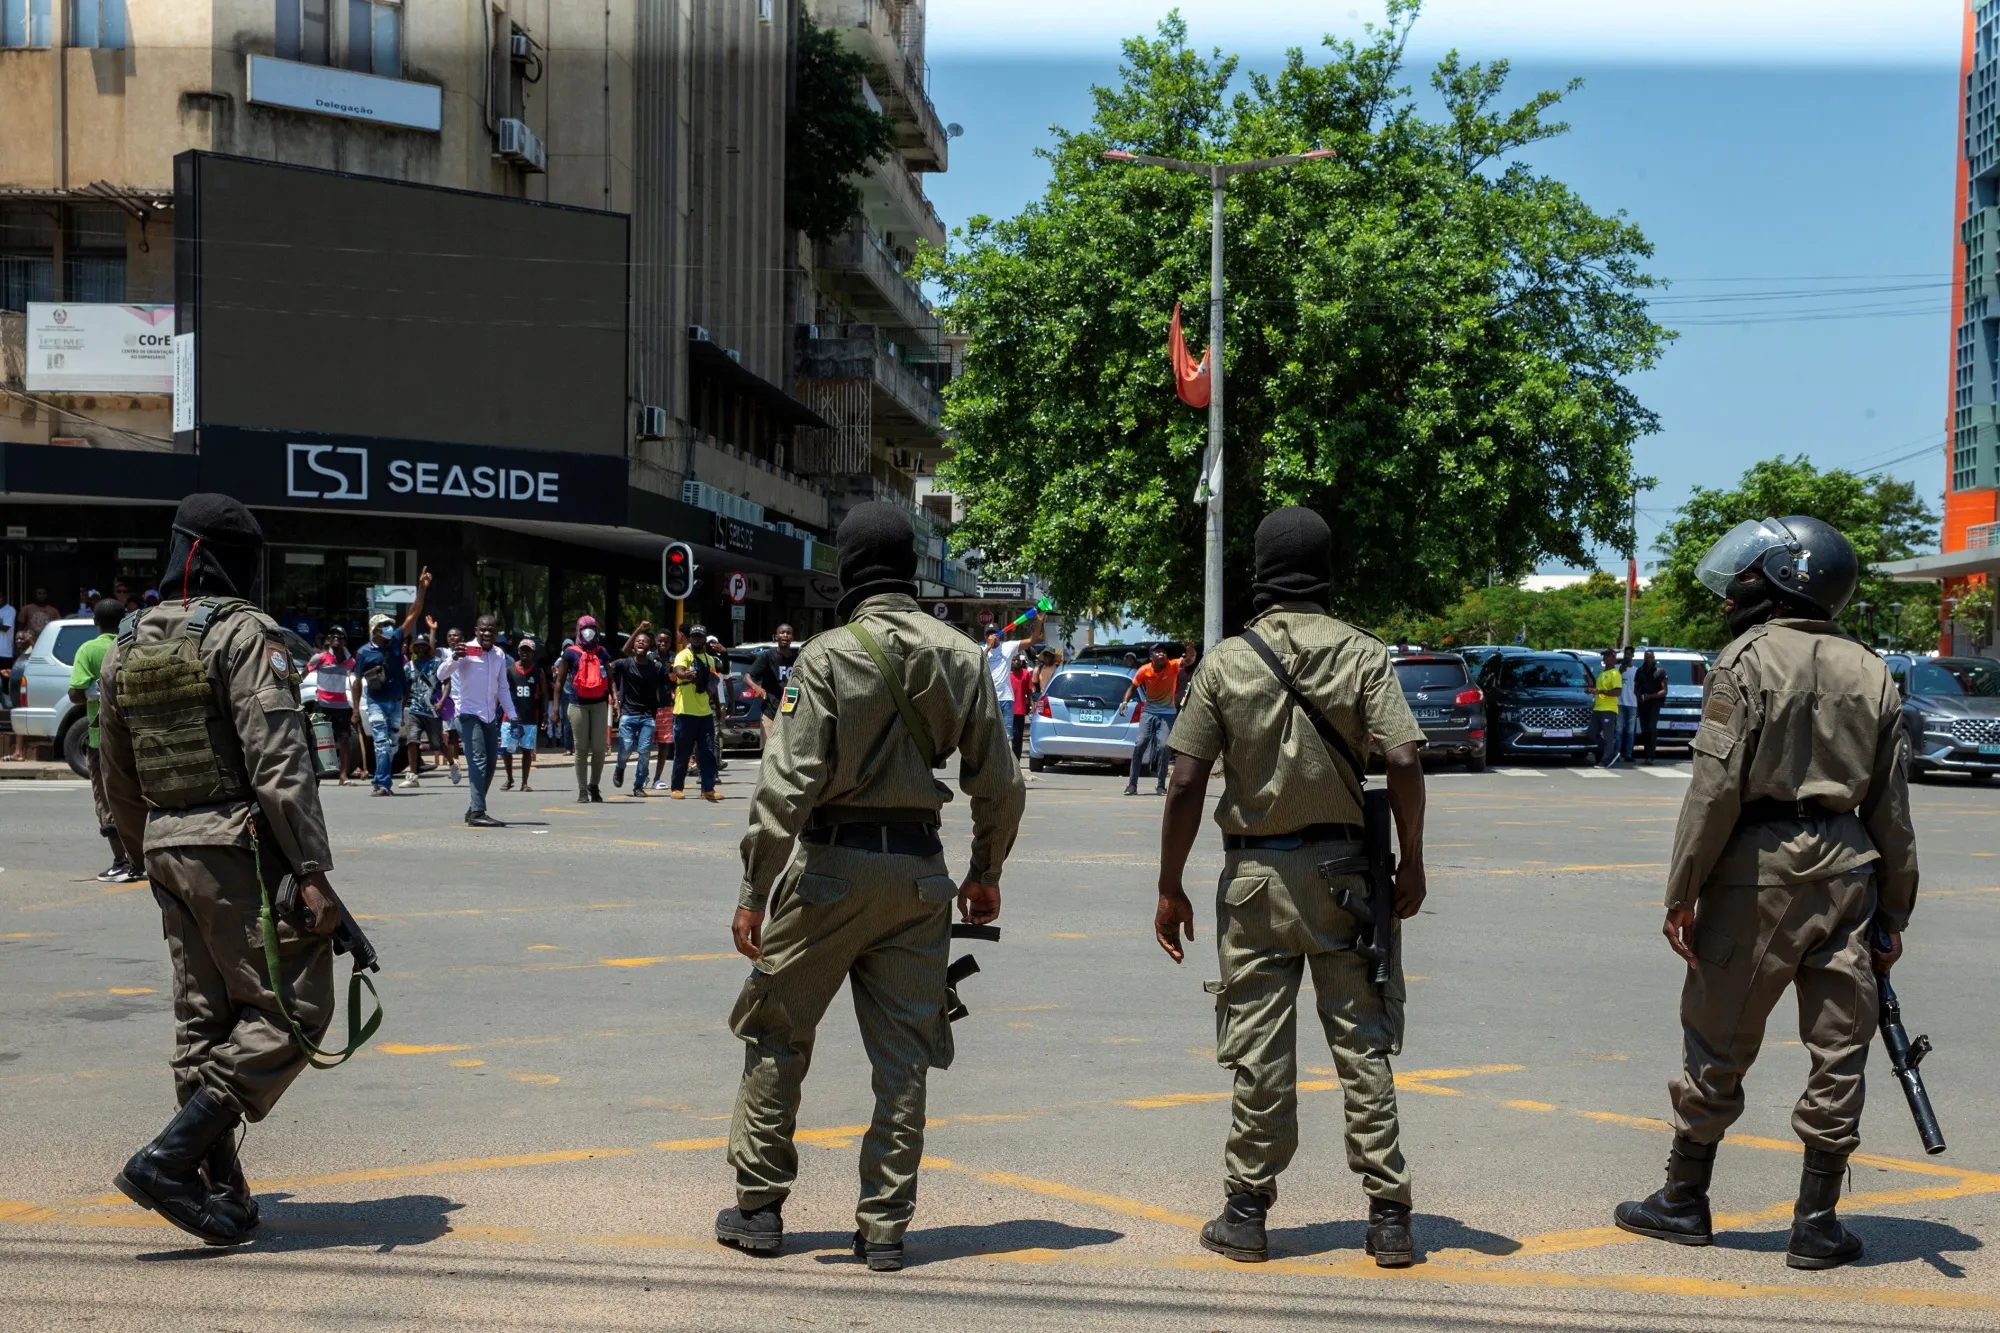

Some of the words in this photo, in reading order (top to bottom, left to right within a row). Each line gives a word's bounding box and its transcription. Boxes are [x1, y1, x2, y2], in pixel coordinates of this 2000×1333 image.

[315, 98, 373, 115] Delegação
[138, 334, 171, 346] COrE
[387, 460, 559, 502] SEASIDE
[979, 614, 992, 622] STOP
[516, 685, 530, 697] 36
